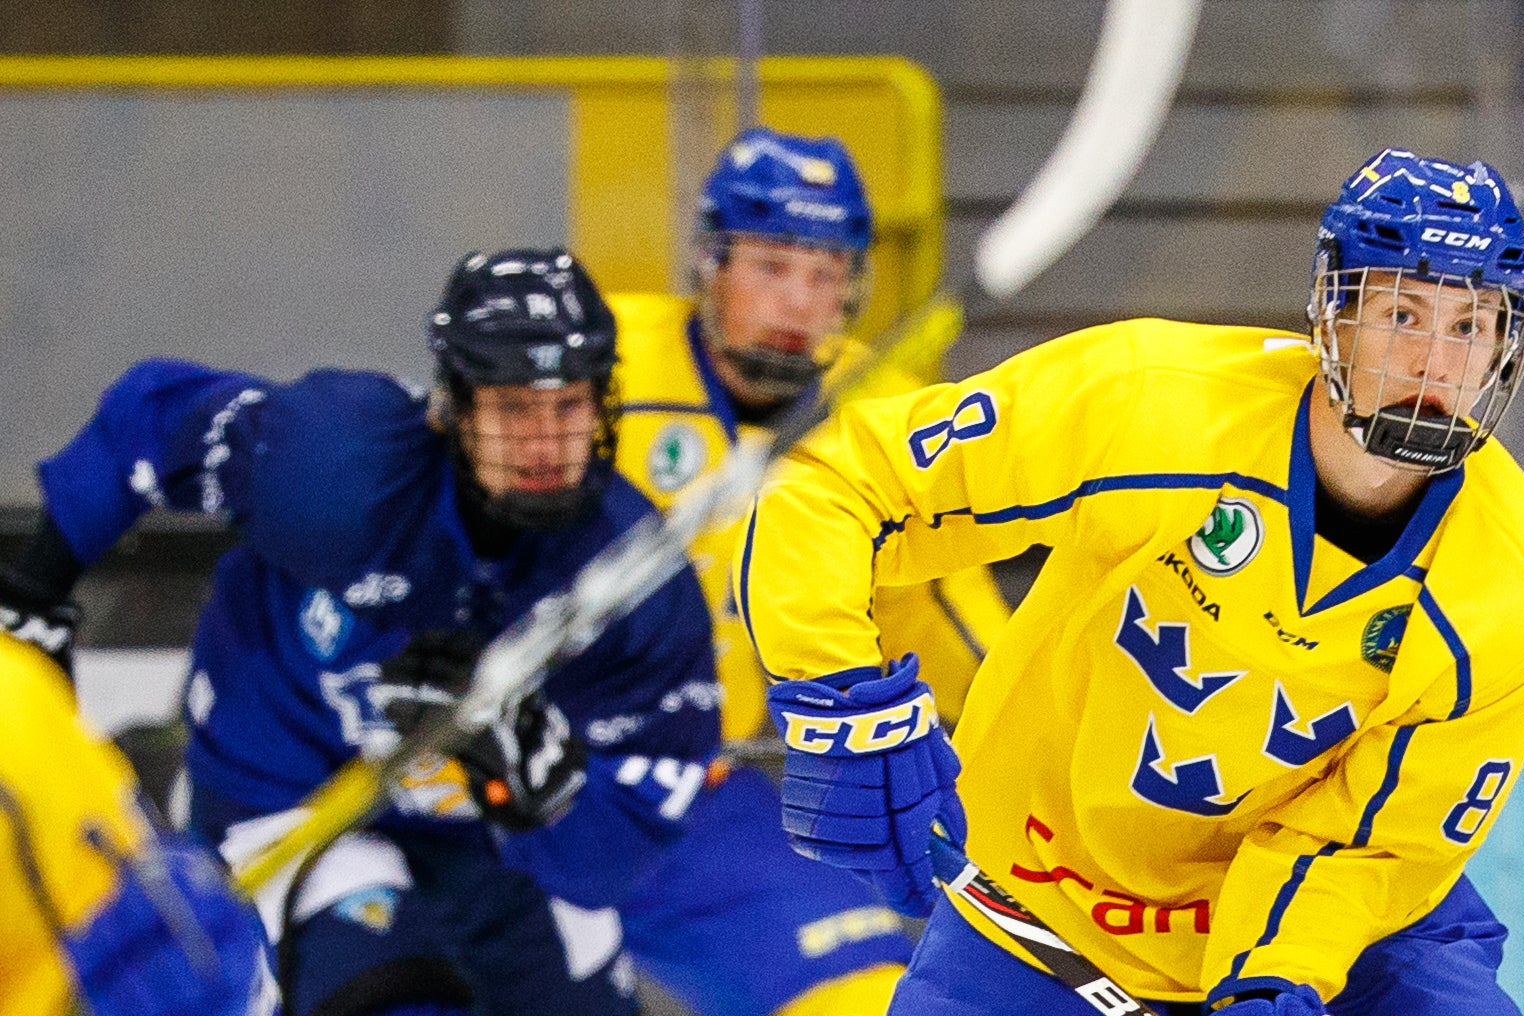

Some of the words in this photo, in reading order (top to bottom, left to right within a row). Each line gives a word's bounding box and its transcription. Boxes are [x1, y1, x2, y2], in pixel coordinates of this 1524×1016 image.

[1420, 226, 1492, 251] CCM
[908, 389, 998, 471] 8
[1440, 758, 1513, 846] 8
